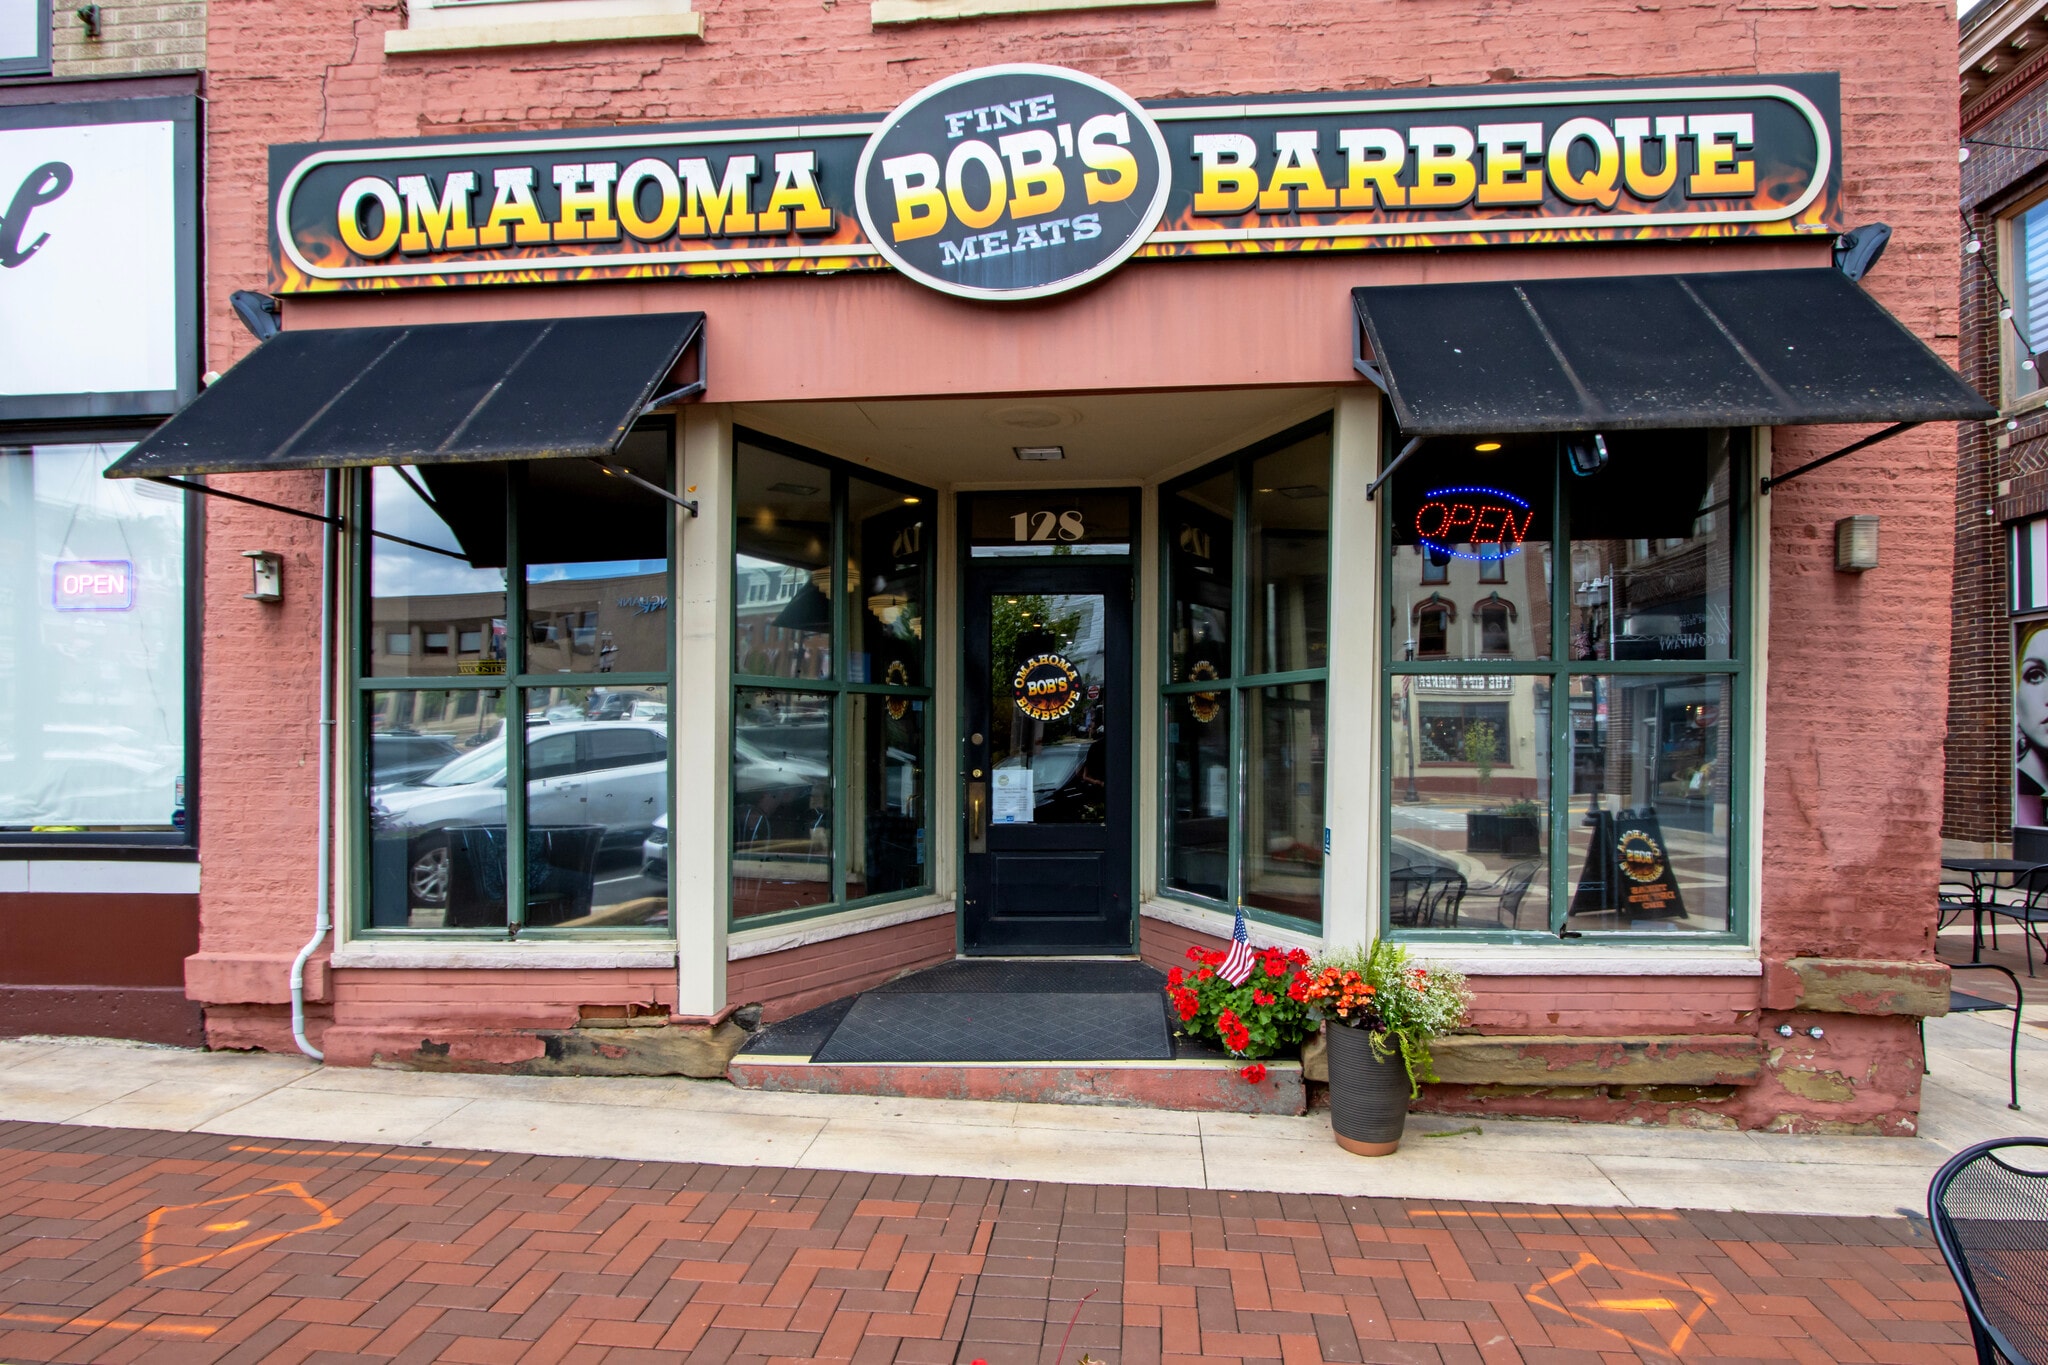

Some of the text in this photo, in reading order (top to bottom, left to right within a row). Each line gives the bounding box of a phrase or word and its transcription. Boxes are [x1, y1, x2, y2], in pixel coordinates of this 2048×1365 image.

[944, 94, 1057, 138] FINE
[338, 112, 1755, 257] OMAHOMA BOB'S BARBEQUE
[938, 212, 1102, 266] MEATS
[1010, 510, 1085, 542] 128
[1415, 502, 1534, 545] OPEN
[63, 574, 125, 595] OPEN
[459, 665, 506, 673] WOOSTER
[1013, 654, 1078, 690] OMAHOMA
[1026, 677, 1068, 697] BOB'S
[1016, 689, 1080, 721] BARBEQUE
